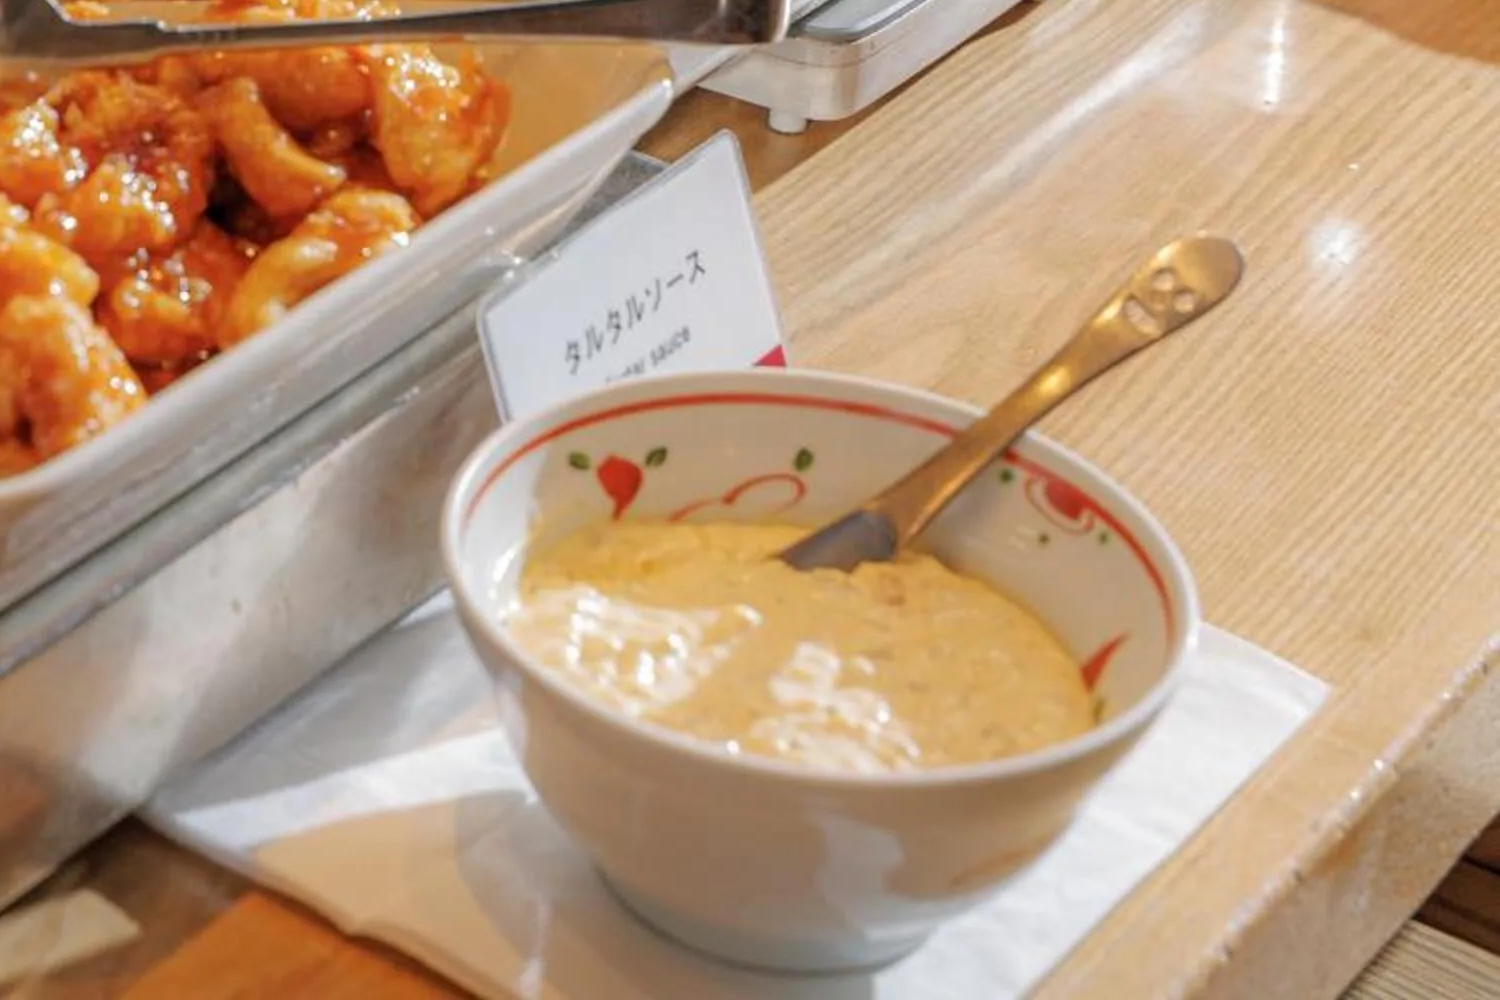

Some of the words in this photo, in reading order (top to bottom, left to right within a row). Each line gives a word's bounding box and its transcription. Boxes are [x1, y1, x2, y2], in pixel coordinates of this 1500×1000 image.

[565, 250, 706, 375] タルタルソース
[650, 326, 691, 368] sauce
